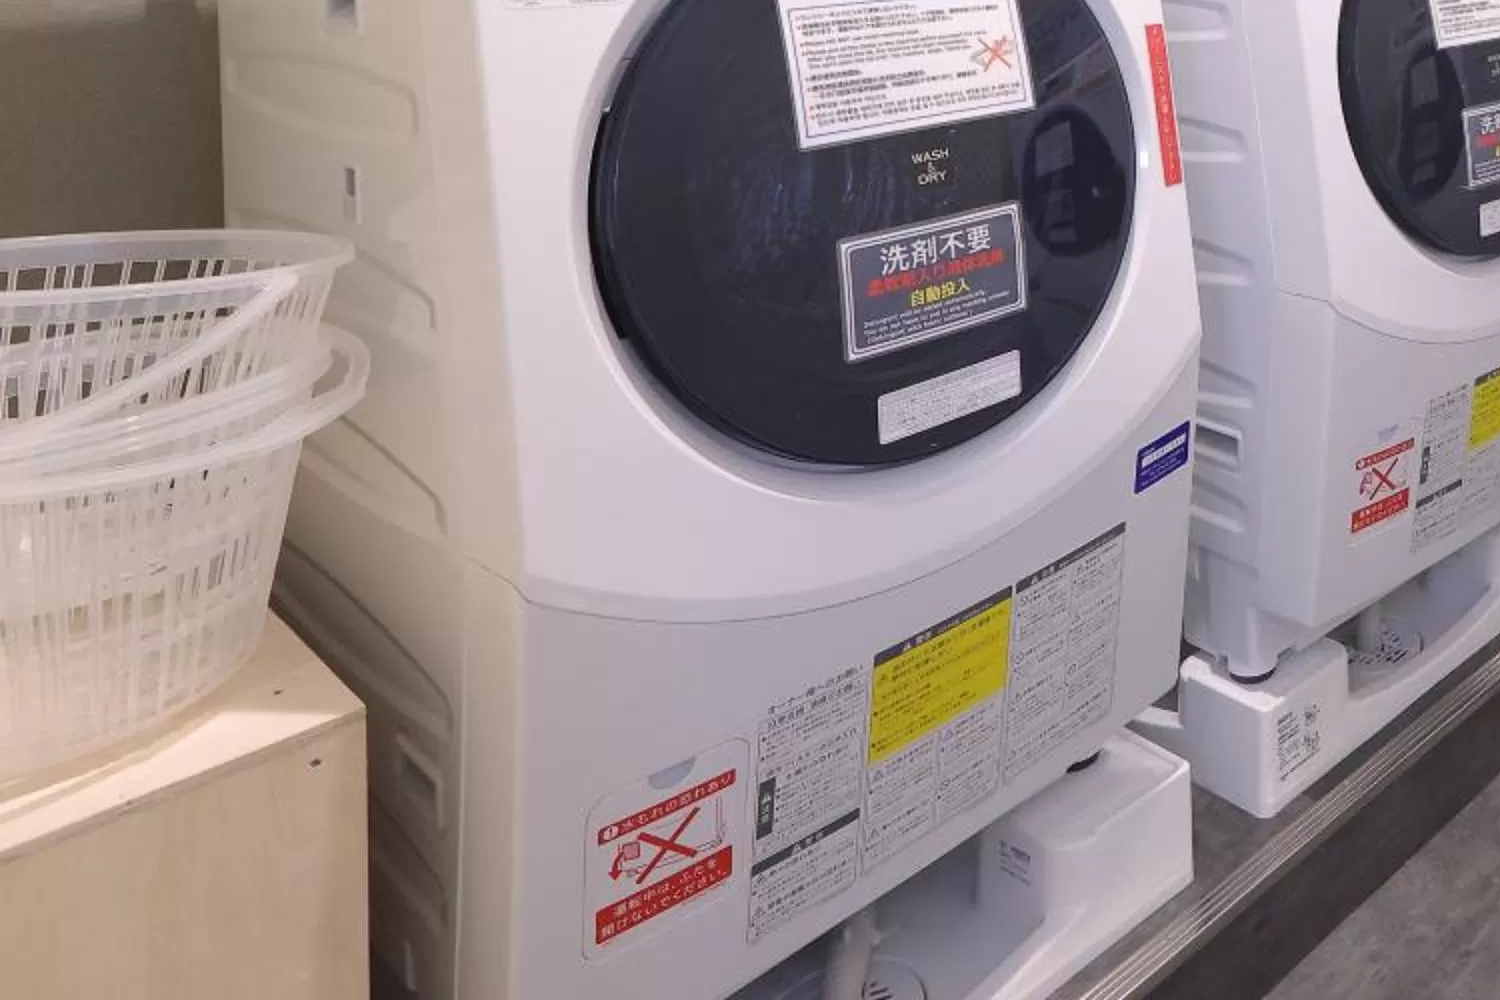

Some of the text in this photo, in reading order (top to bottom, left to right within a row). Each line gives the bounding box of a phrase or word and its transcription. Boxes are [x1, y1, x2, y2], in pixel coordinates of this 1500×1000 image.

[911, 148, 949, 165] WASH
[917, 170, 947, 185] DRY
[879, 225, 991, 276] 洗剤不要
[910, 277, 971, 307] 自動投入
